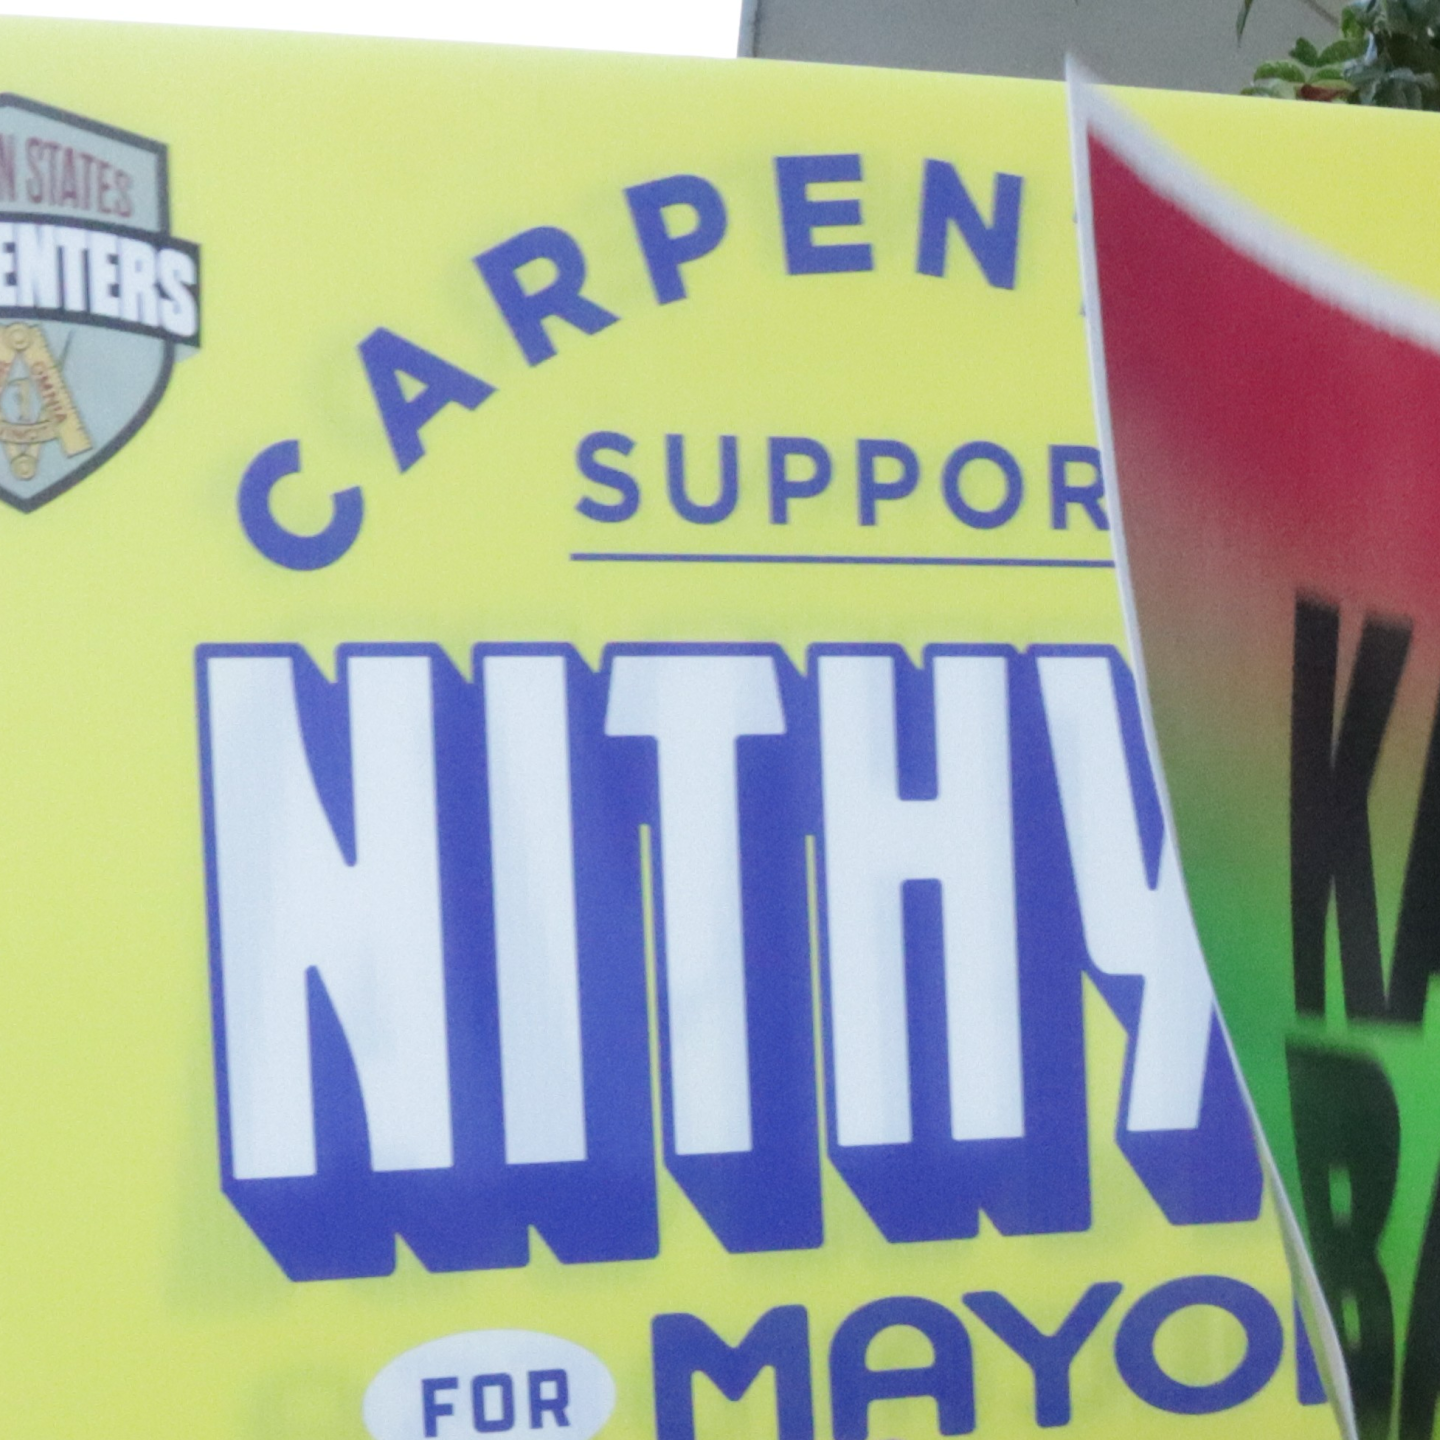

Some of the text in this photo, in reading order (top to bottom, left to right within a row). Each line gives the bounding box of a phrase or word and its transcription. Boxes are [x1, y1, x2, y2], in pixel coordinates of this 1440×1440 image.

[26, 136, 133, 219] STATES
[237, 154, 1085, 572] CARPEN
[574, 431, 1110, 530] SUPPOR
[195, 642, 1264, 1283] NITHY
[421, 1368, 571, 1438] FOR
